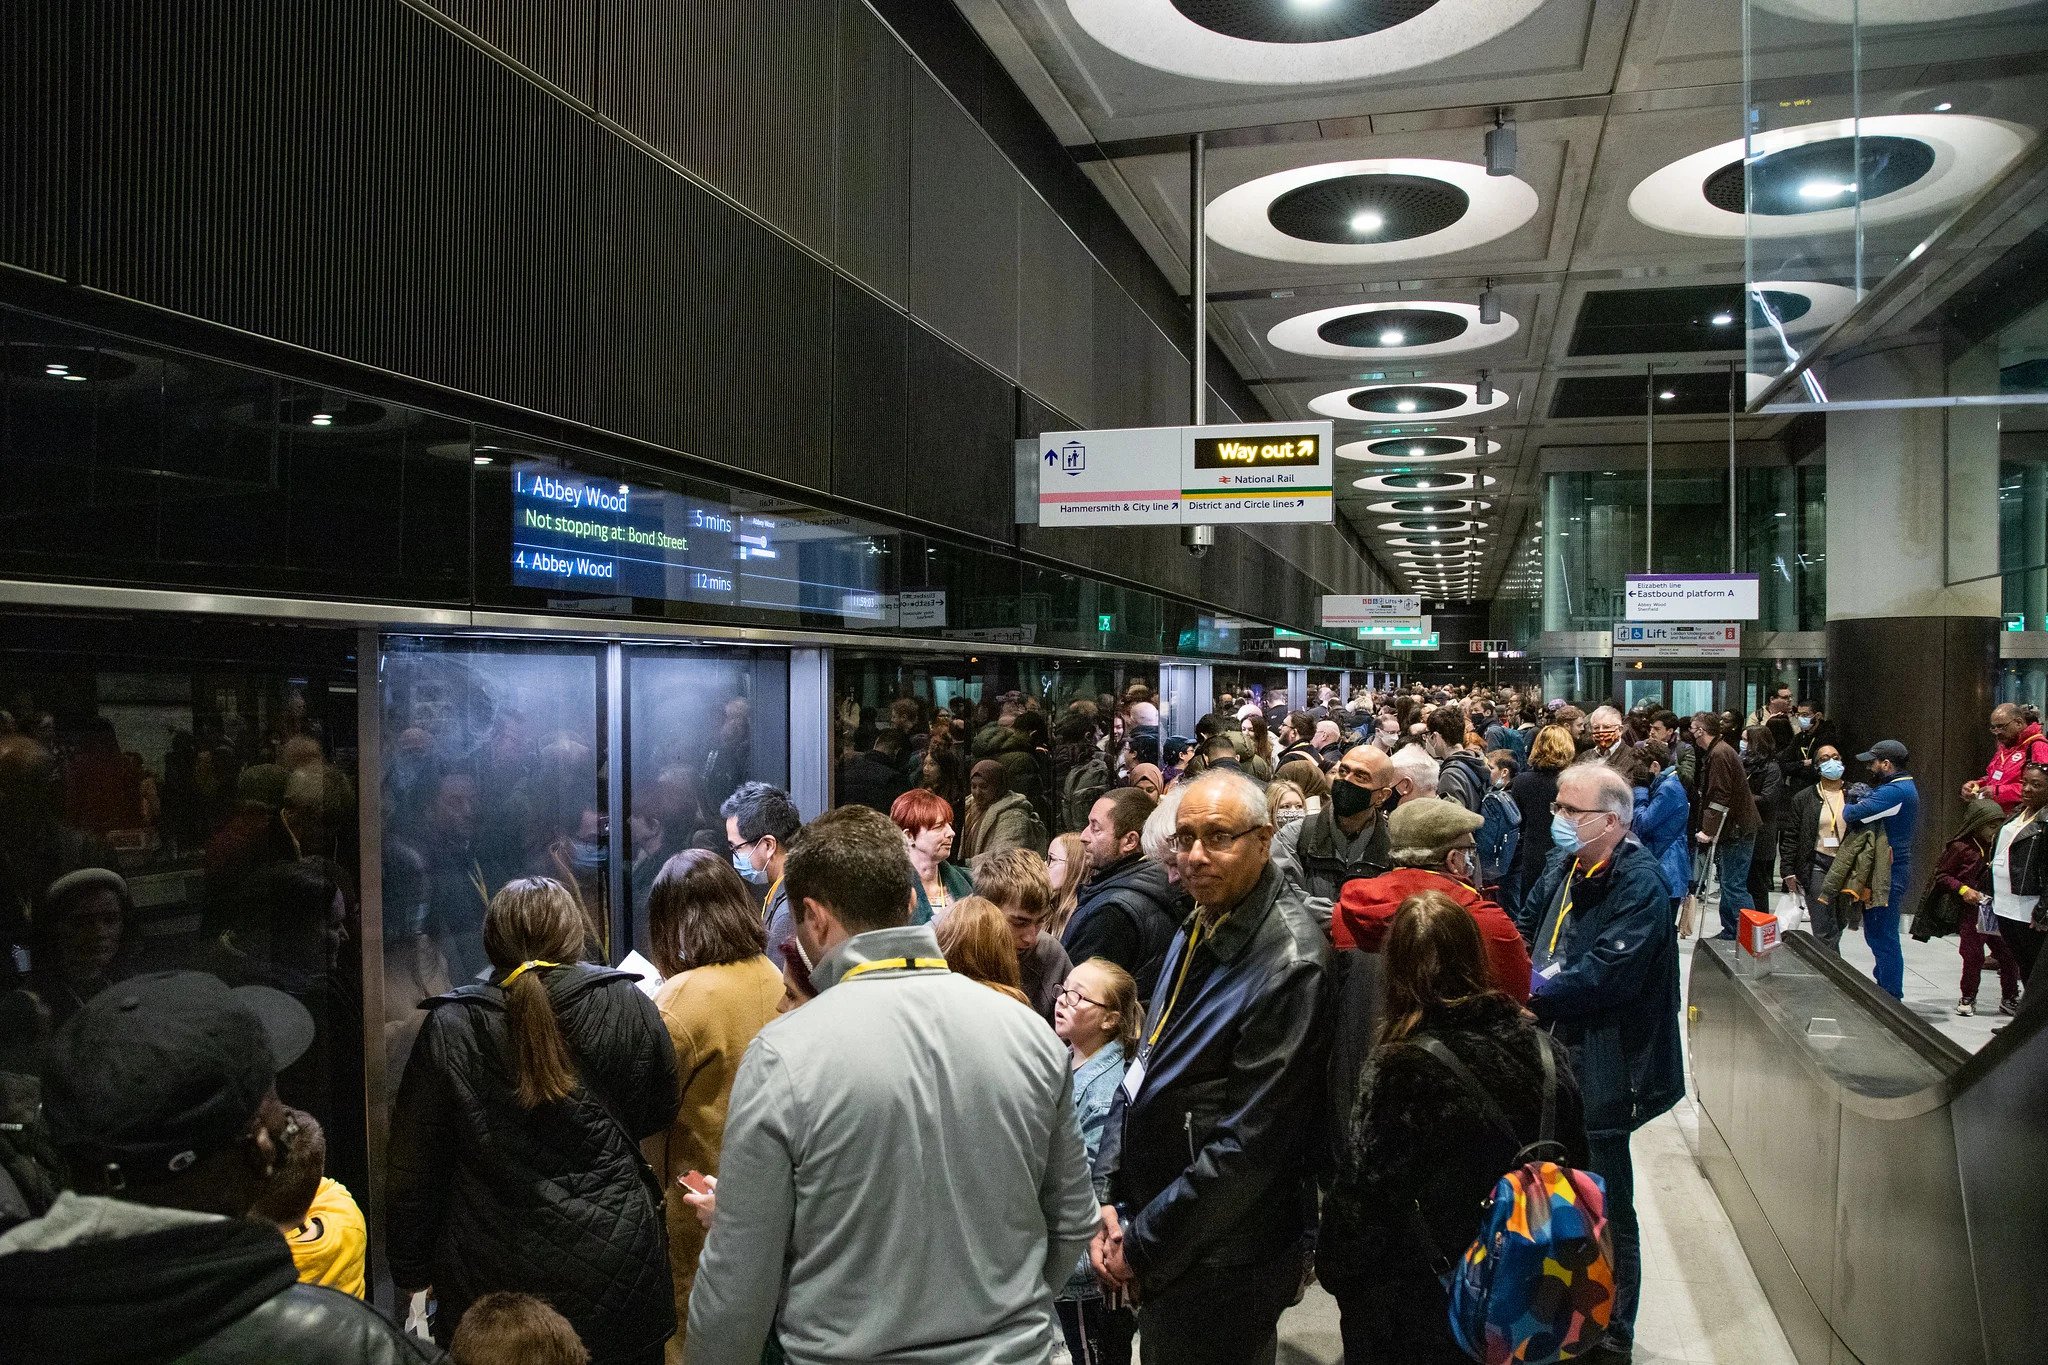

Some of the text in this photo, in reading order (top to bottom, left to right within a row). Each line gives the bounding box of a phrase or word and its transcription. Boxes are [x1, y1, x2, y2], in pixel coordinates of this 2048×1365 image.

[1218, 442, 1294, 463] Way out
[1234, 474, 1295, 484] National Rail
[533, 475, 582, 508] Abbey
[586, 485, 627, 513] Wood
[1060, 502, 1169, 513] Hammersmith & City line
[1189, 499, 1294, 510] District and Circle lines
[695, 509, 732, 533] 5 mins
[525, 508, 689, 550] Not stopping at: Bond Street.
[516, 550, 613, 578] 4. Abbey Wood
[696, 573, 732, 591] 12 mins
[1637, 589, 1735, 599] Eastbound platform A
[1646, 628, 1667, 639] Lift
[1727, 631, 1733, 639] 8
[1053, 660, 1060, 670] 3
